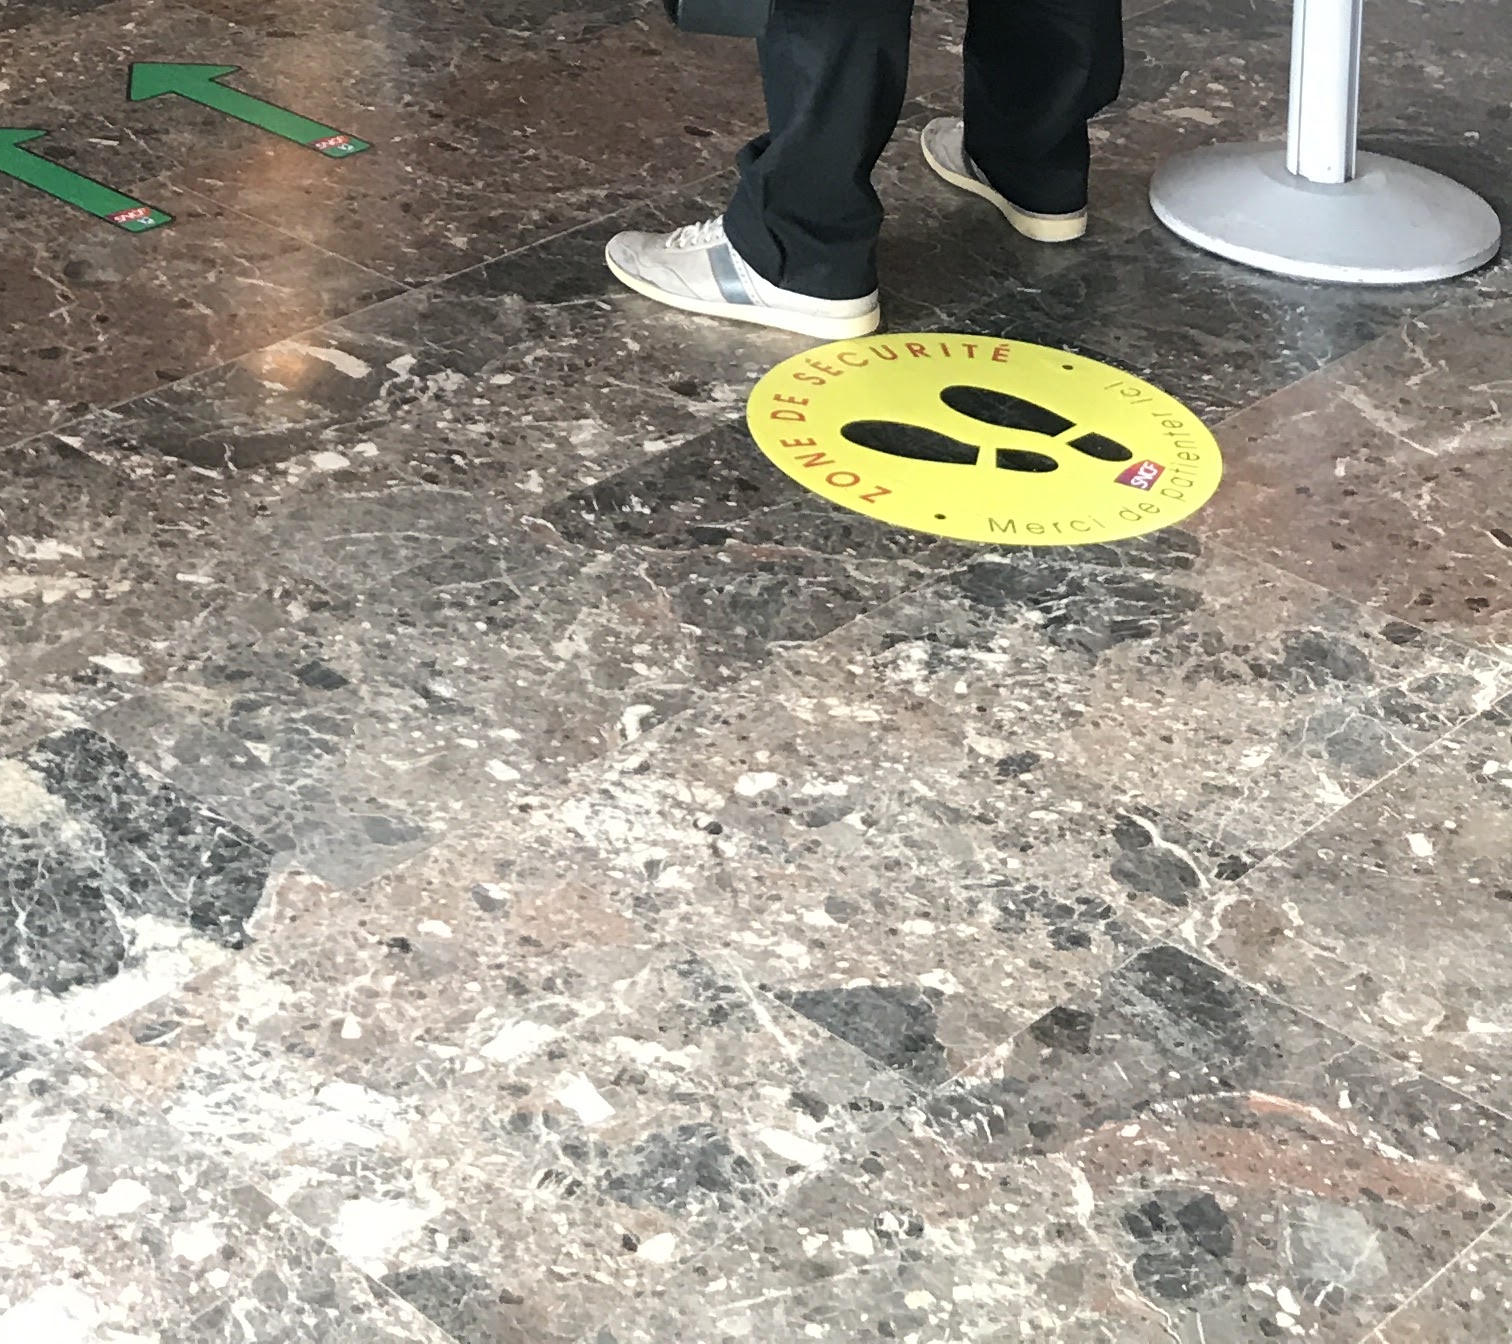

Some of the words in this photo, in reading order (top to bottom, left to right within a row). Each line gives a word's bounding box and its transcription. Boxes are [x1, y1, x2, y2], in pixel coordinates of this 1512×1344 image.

[792, 343, 1012, 387] SÉCURITÉ
[770, 393, 809, 423] DE
[781, 436, 893, 504] ZONE
[987, 514, 1107, 536] Merci
[1118, 501, 1161, 522] de
[1151, 411, 1201, 503] patienter
[1130, 461, 1159, 489] SNCF
